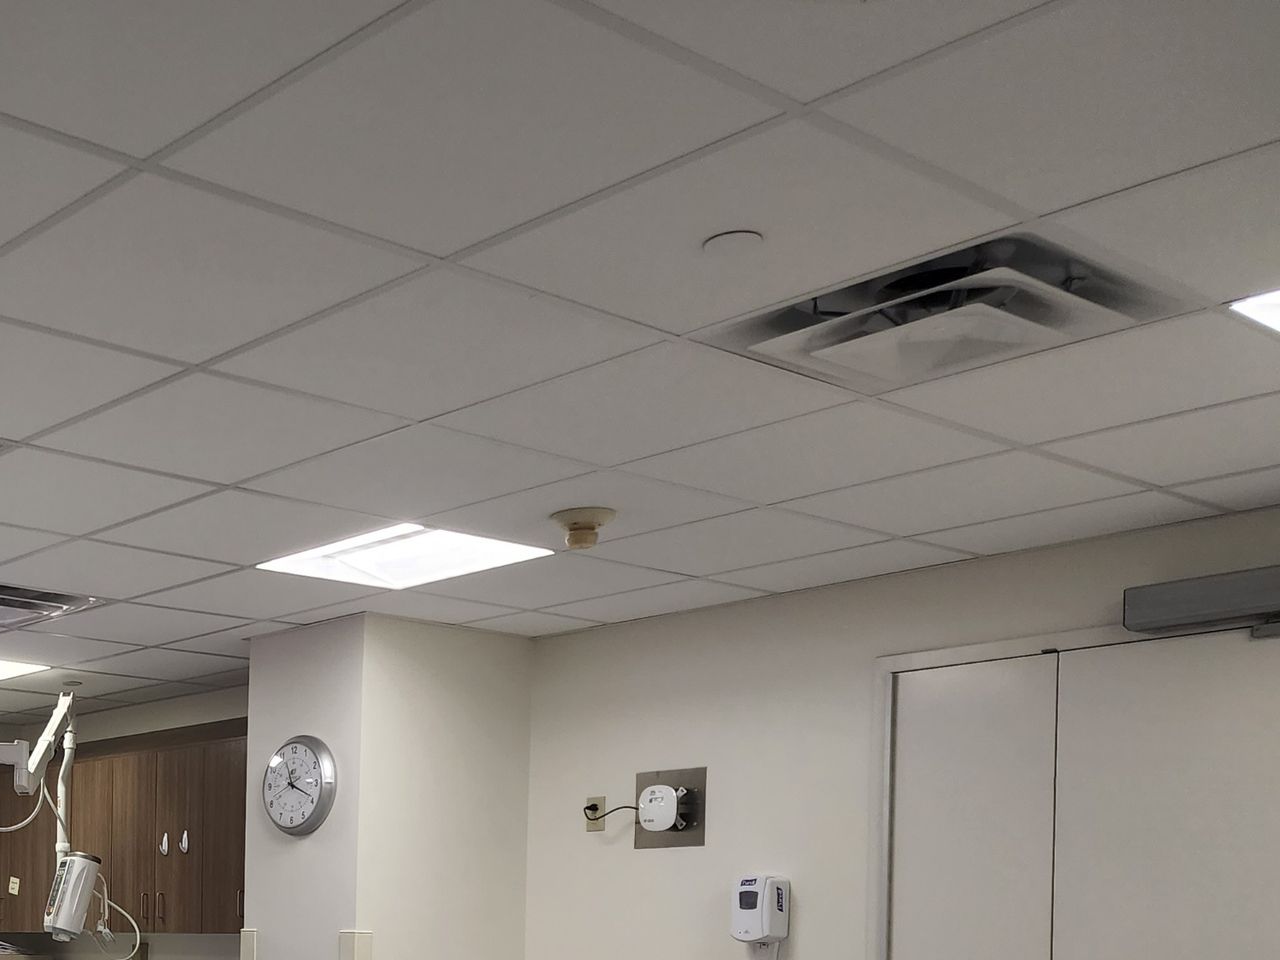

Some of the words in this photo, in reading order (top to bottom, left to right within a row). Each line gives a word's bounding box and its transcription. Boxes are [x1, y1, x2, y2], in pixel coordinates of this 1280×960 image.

[291, 746, 298, 754] 12
[312, 761, 317, 770] 2
[268, 782, 272, 791] 9
[314, 779, 318, 788] 3
[270, 800, 274, 808] 8
[279, 812, 283, 820] 7
[302, 811, 306, 820] 5
[290, 816, 294, 824] 6
